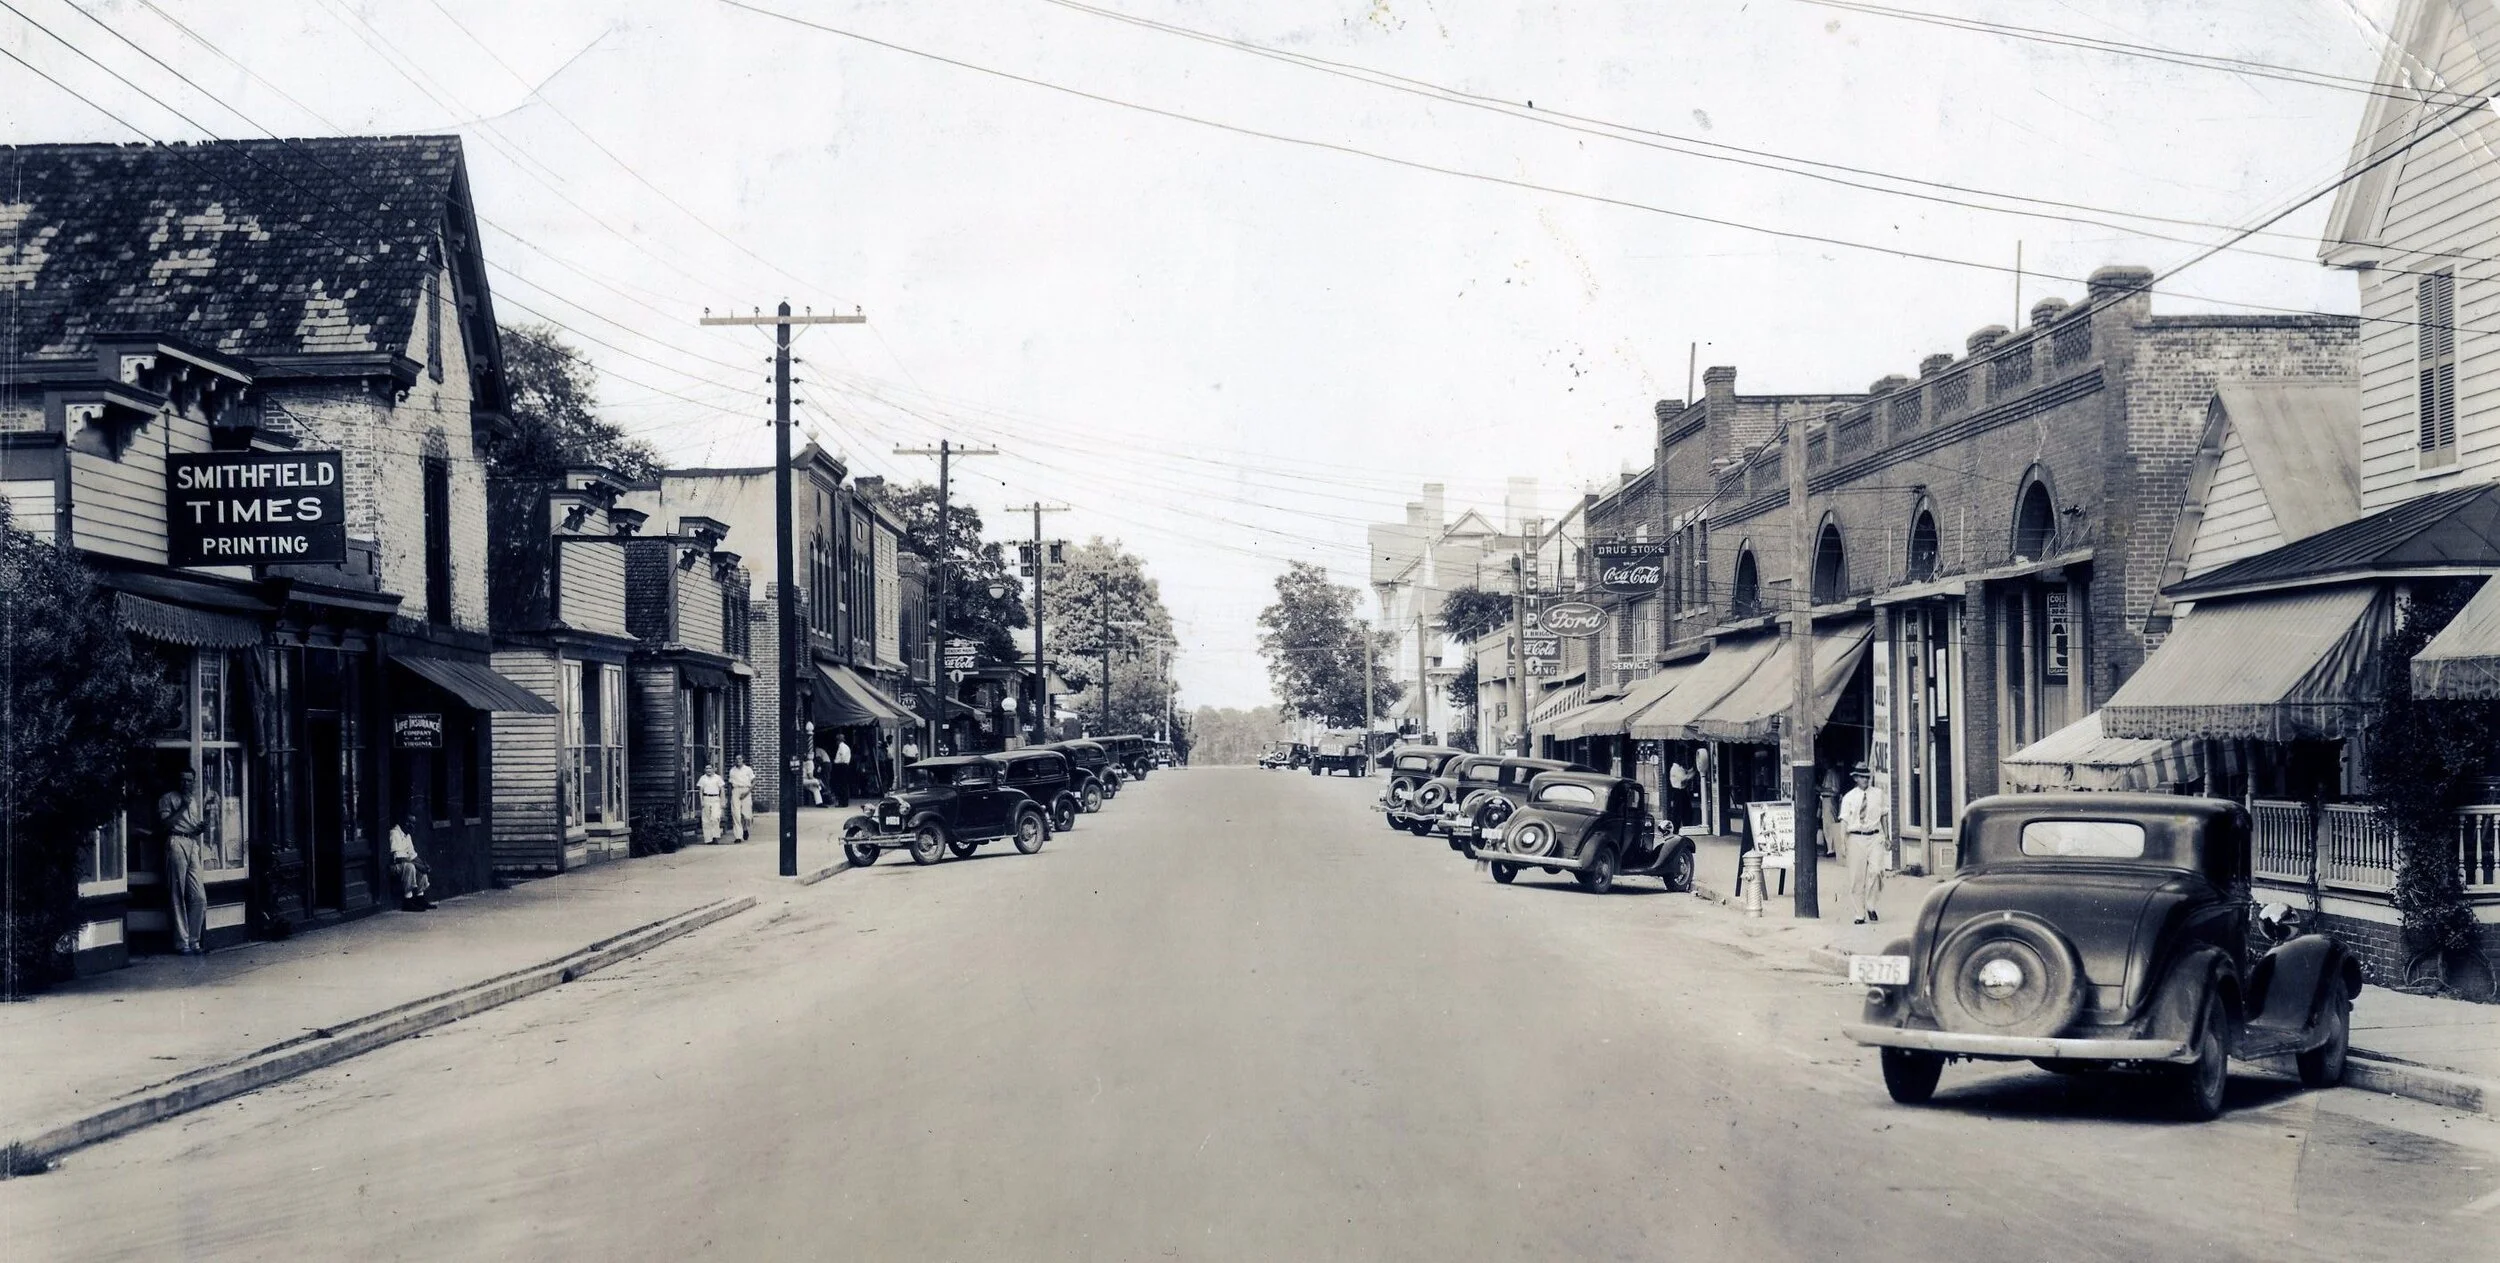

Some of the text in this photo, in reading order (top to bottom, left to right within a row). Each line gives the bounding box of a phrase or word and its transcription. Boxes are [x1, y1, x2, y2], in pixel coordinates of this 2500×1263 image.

[176, 461, 335, 490] SMITHFIELD
[186, 496, 323, 524] TIMES
[202, 535, 309, 556] PRINTING
[1598, 545, 1627, 555] DRUG
[1603, 566, 1661, 585] Coca-Cola
[1549, 607, 1601, 629] Ford
[1612, 662, 1649, 670] SERVICE
[395, 720, 408, 733] LIFE
